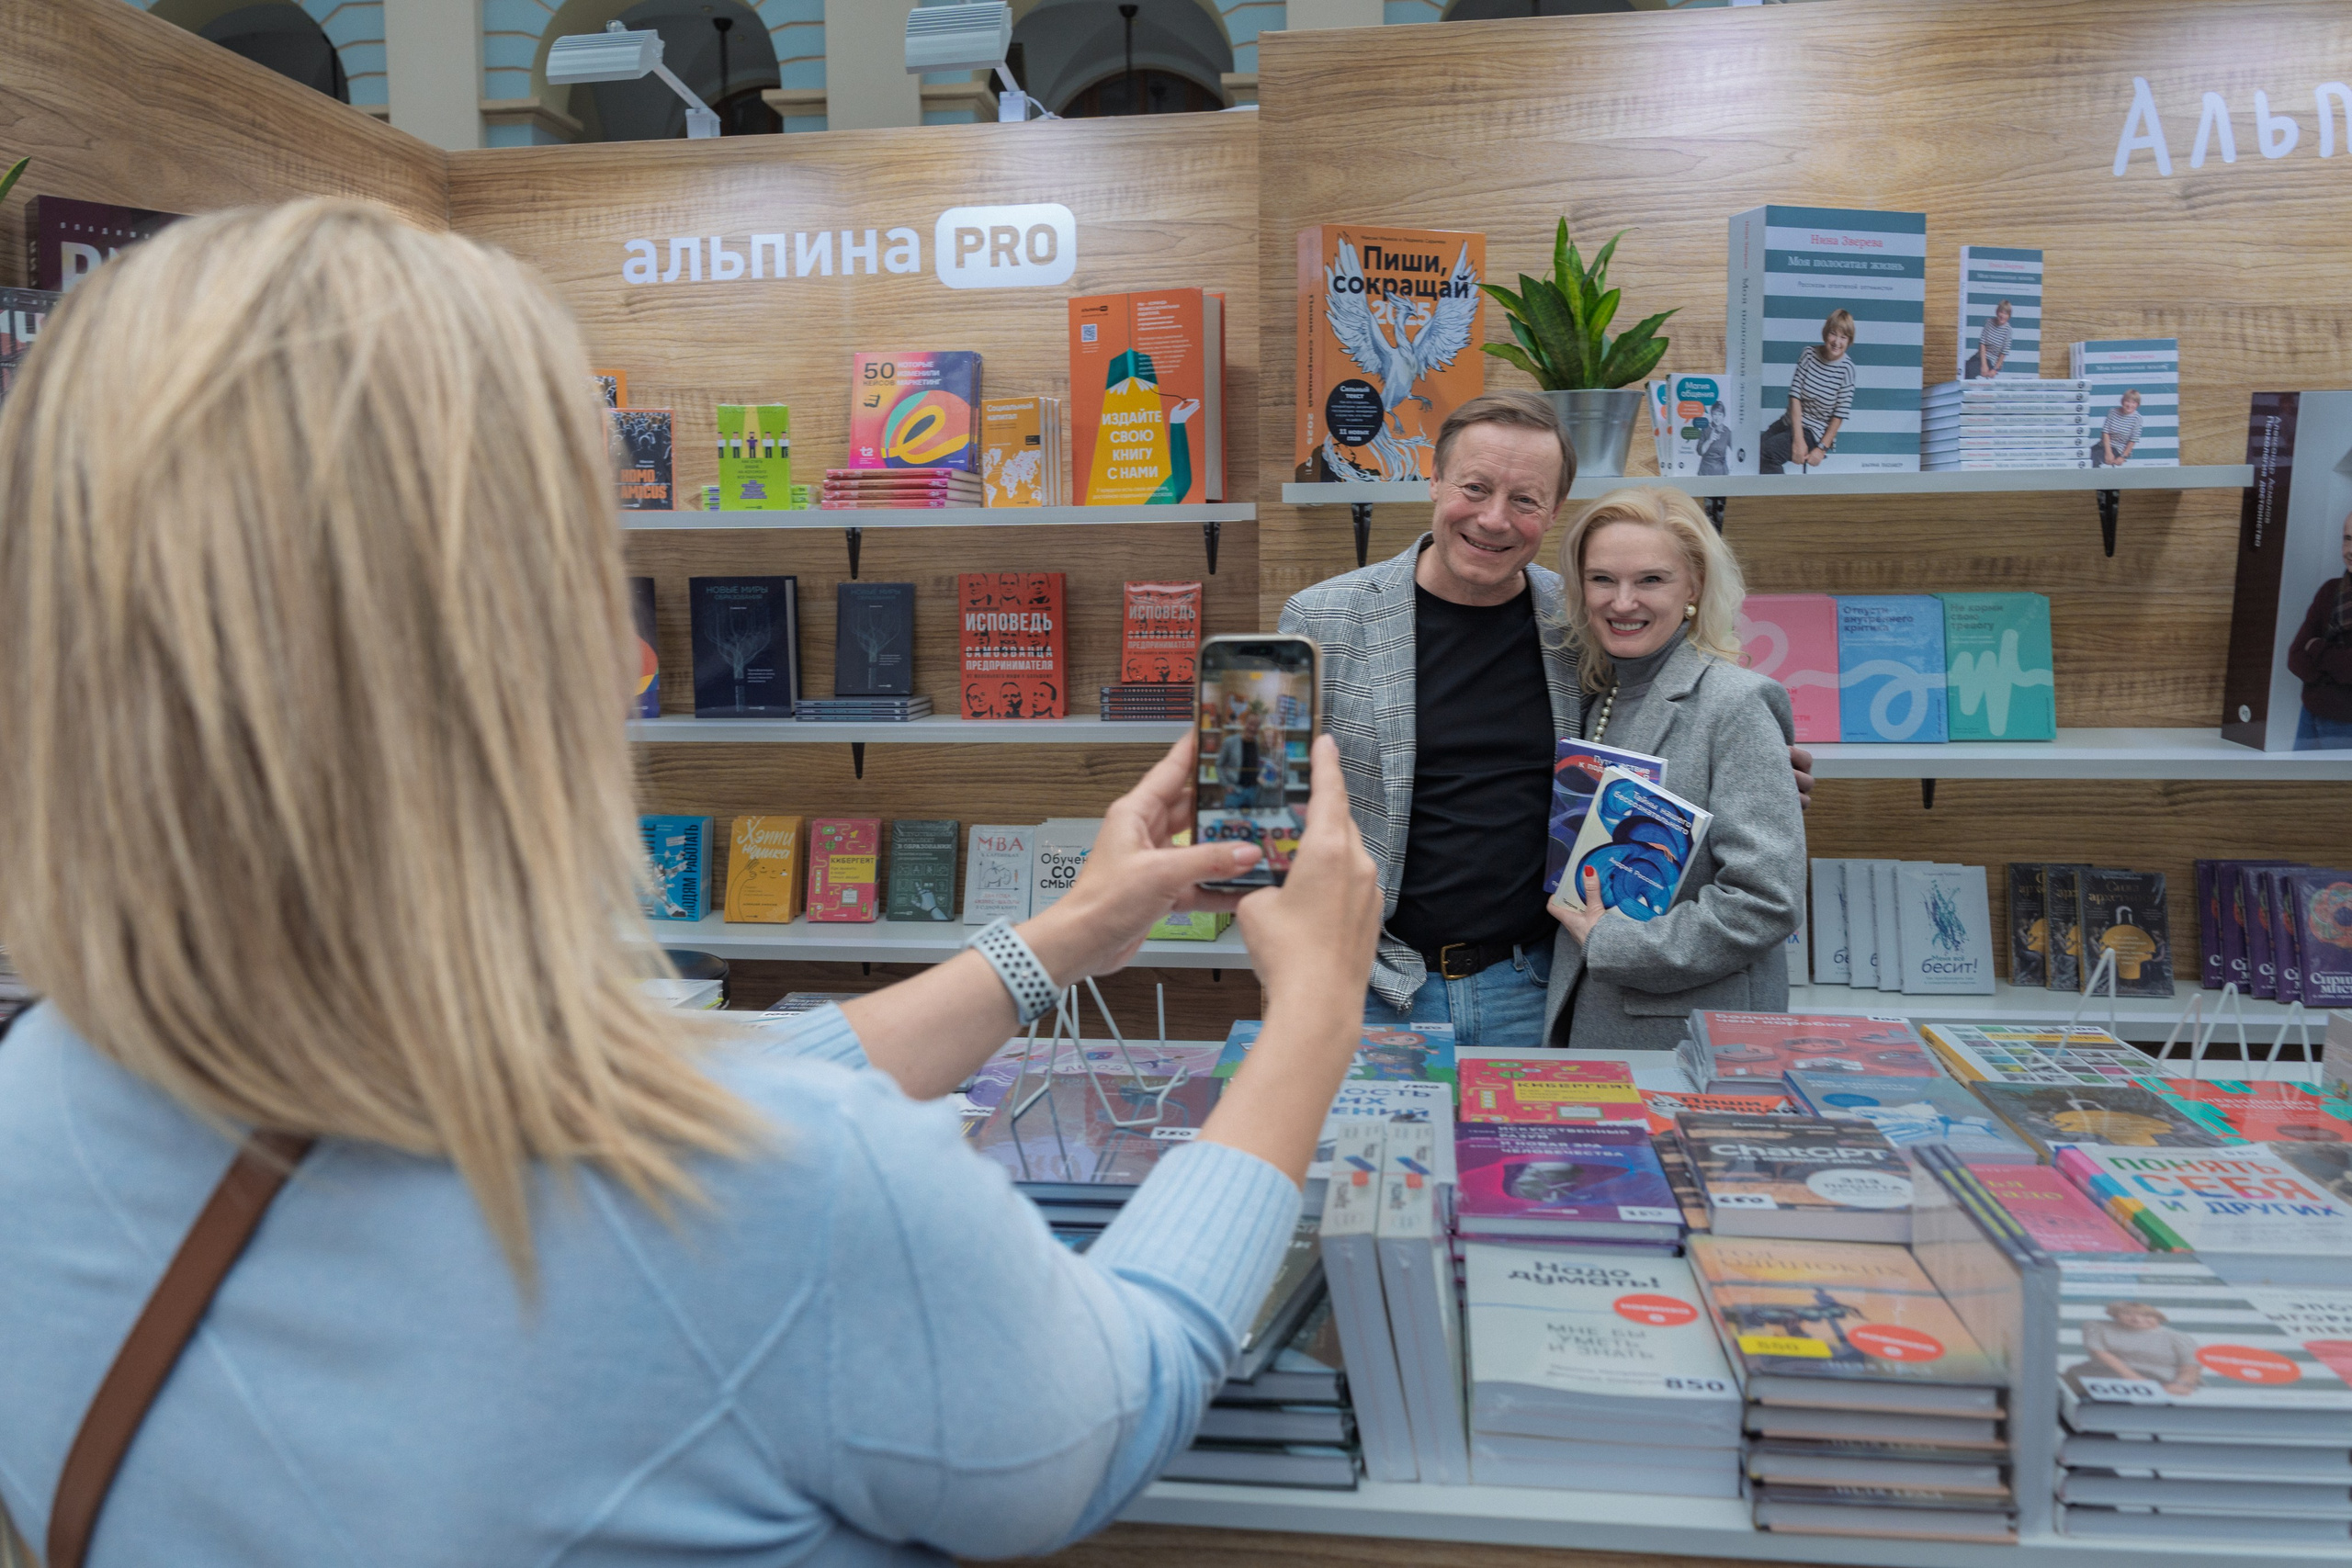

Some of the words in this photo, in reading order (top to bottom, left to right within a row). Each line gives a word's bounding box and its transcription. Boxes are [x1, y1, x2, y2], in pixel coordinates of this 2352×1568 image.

[954, 223, 1058, 269] PRO
[1811, 234, 1838, 245] Нина
[1842, 235, 1883, 249] Зверева
[622, 226, 922, 285] альпина
[1363, 245, 1447, 276] Пиши,
[1788, 255, 1811, 267] Моя
[1813, 258, 1868, 270] полосатая
[1870, 261, 1905, 272] жизнь
[1333, 275, 1469, 301] сокращай
[864, 362, 895, 379] 50
[897, 369, 941, 378] ИЗМЕНИЛИ
[896, 378, 943, 387] МАРКЕТИНГ
[1685, 381, 1711, 389] Магия
[1680, 389, 1714, 399] общения
[987, 402, 1035, 413] Социальный
[1102, 408, 1162, 426] ИЗДАЙТЕ
[1109, 429, 1154, 444] СВОЮ
[2269, 415, 2283, 475] Александр
[1112, 447, 1153, 462] КНИГУ
[620, 469, 655, 482] HOMO
[1107, 467, 1118, 479] С
[1120, 466, 1159, 479] НАМИ
[620, 485, 667, 500] AMICUS
[2264, 478, 2277, 524] Асмолов
[1129, 605, 1196, 620] ИСПОВЕДЬ
[1844, 606, 1888, 615] Отпусти
[1951, 604, 1965, 612] Не
[1970, 604, 2004, 613] корми
[966, 613, 1053, 632] ИСПОВЕДЬ
[1844, 615, 1914, 625] внутреннего
[1951, 621, 1995, 631] тревогу
[1127, 630, 1195, 639] САМОЗВАНЦА
[1844, 625, 1889, 633] критика
[1127, 640, 1195, 649] ПРЕДПРИНИМАТЕЛЯ
[966, 646, 1054, 659] САМОЗВАНЦА
[966, 660, 1054, 671] ПРЕДПРИНИМАТЕЛЯ
[1613, 791, 1689, 836] бессознательного
[1634, 791, 1658, 810] Тайны
[1659, 805, 1691, 828] нашего
[736, 817, 796, 846] Хэппи
[684, 825, 699, 873] РАБОТАТЬ
[978, 837, 1024, 852] MBA
[1922, 958, 1979, 974] бесит!
[1714, 1013, 1800, 1022] Больше,
[1762, 1020, 1852, 1028] коробка
[1680, 1096, 1768, 1106] Пиши,
[1498, 1126, 1629, 1135] ИСКУССТВЕННЫЙ
[1500, 1148, 1624, 1157] ЧЕЛОВЕЧЕСТВА
[1710, 1144, 1888, 1160] ChatGPT
[2108, 1157, 2282, 1174] ПОНЯТЬ
[2132, 1174, 2323, 1201] СЕБЯ
[2160, 1200, 2189, 1213] И
[2205, 1201, 2346, 1217] ДРУГИХ
[1534, 1261, 1630, 1278] Надо
[1508, 1269, 1660, 1288] думать!
[1547, 1323, 1598, 1336] МНЕ
[1611, 1330, 1646, 1338] БЫ
[1560, 1335, 1640, 1348] УМЕТЬ
[1577, 1345, 1655, 1359] ЗНАТЬ
[1665, 1377, 1725, 1392] 850
[2088, 1383, 2154, 1396] 600
